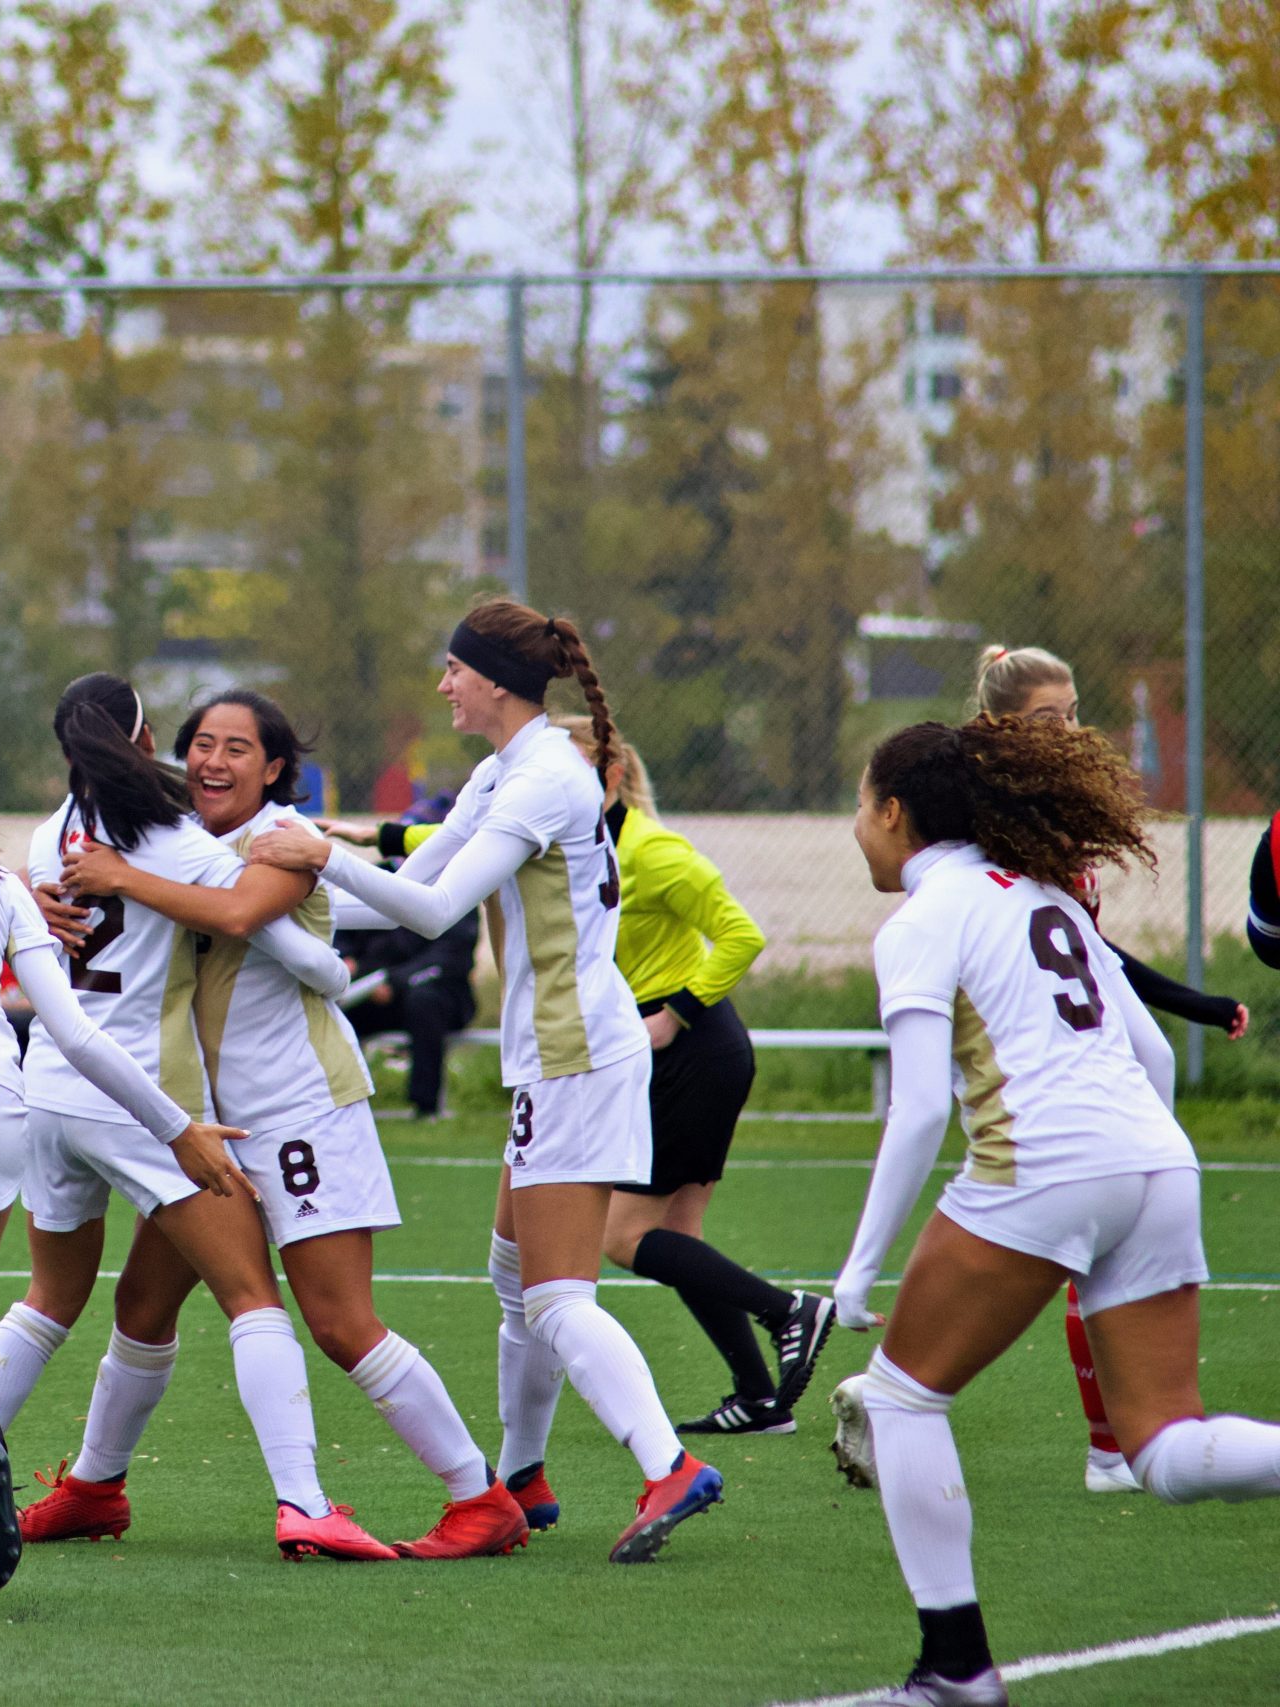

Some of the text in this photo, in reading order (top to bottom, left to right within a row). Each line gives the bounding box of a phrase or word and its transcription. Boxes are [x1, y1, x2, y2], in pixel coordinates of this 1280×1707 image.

[70, 894, 125, 994] 2
[1028, 905, 1105, 1032] 9
[278, 1139, 321, 1198] 8
